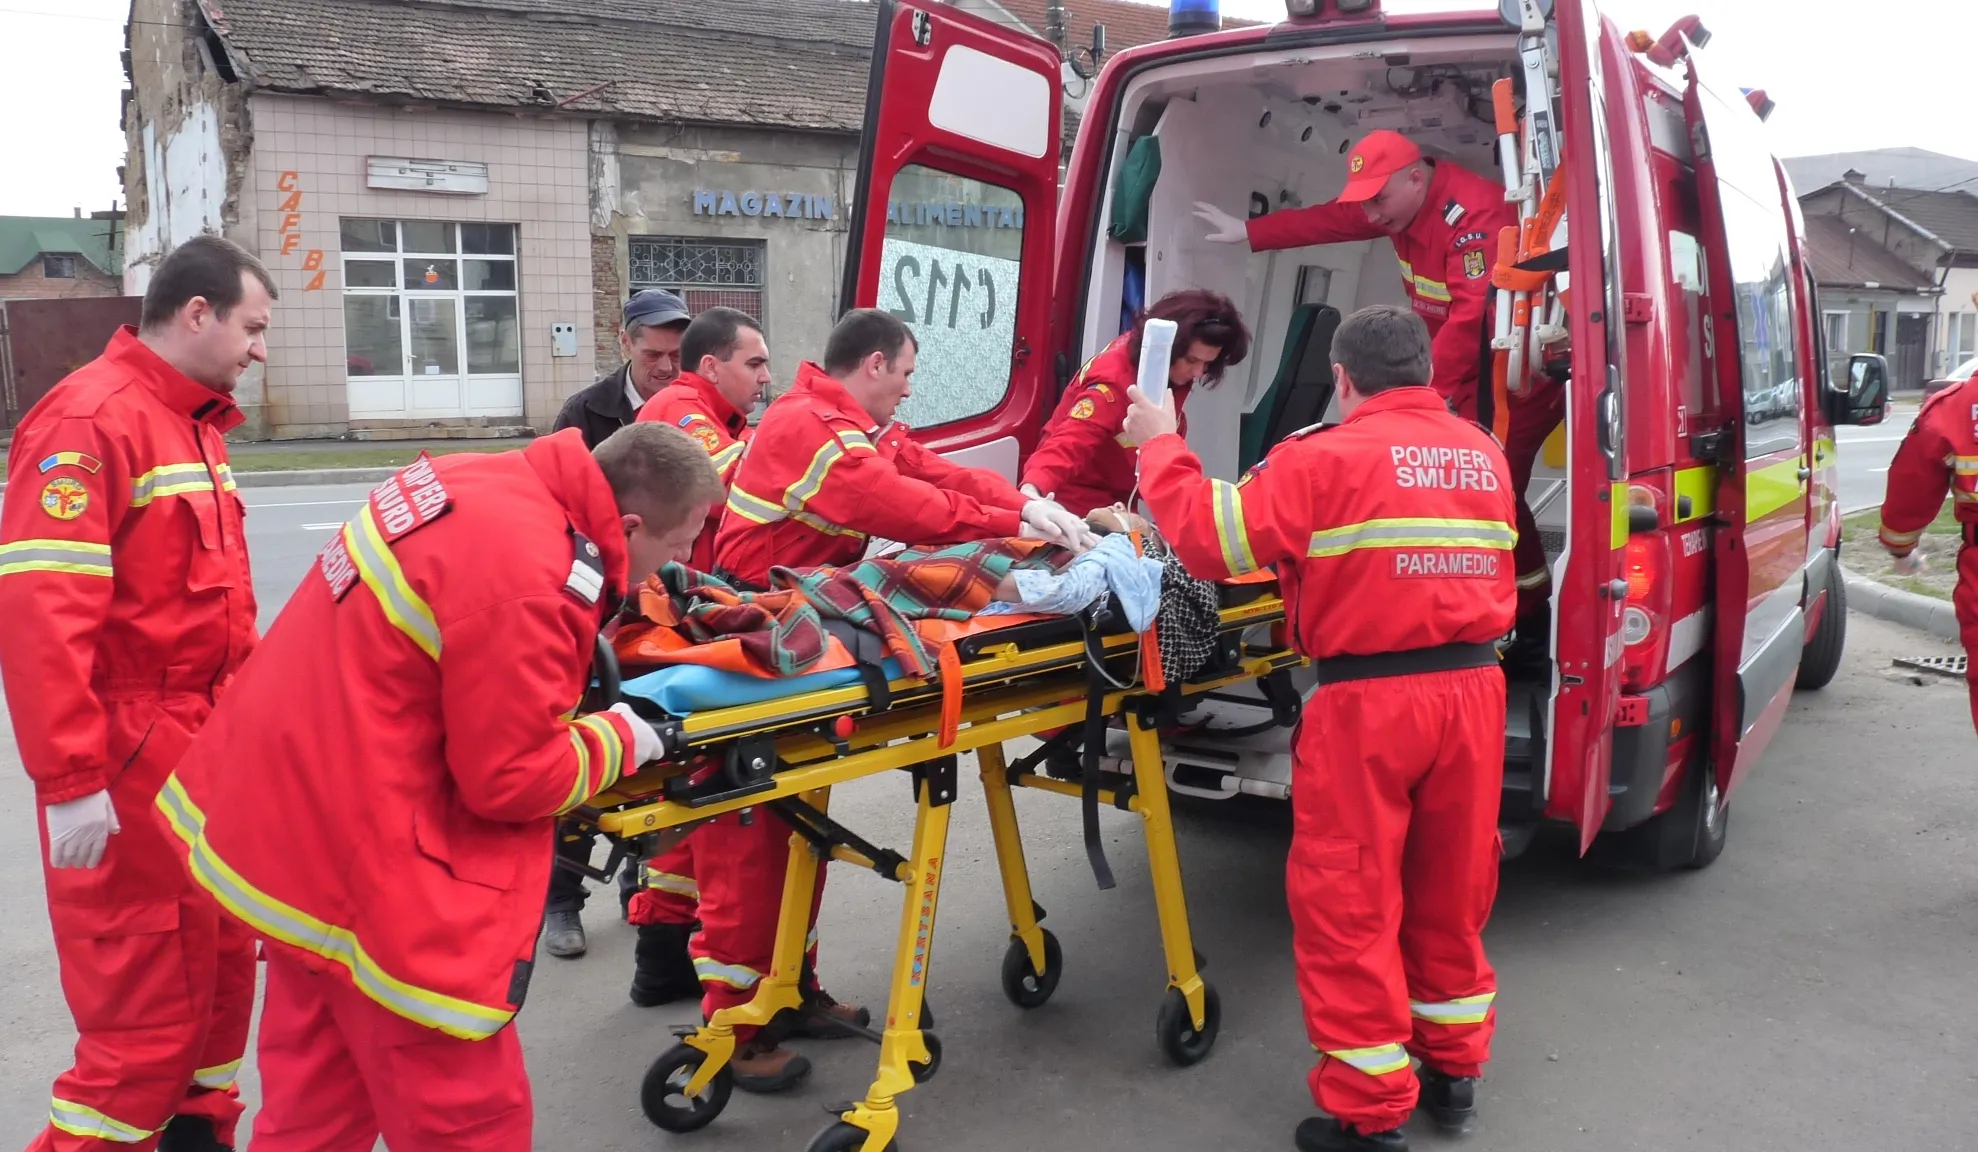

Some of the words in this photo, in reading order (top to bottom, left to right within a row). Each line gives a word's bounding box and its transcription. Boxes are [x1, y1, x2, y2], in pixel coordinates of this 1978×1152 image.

[693, 190, 833, 220] MAGAZIN
[277, 169, 303, 255] CAFE
[302, 248, 326, 291] BA
[1396, 466, 1498, 491] SMURD
[1396, 553, 1497, 576] PARAMEDIC
[911, 857, 938, 983] KARTSANA
